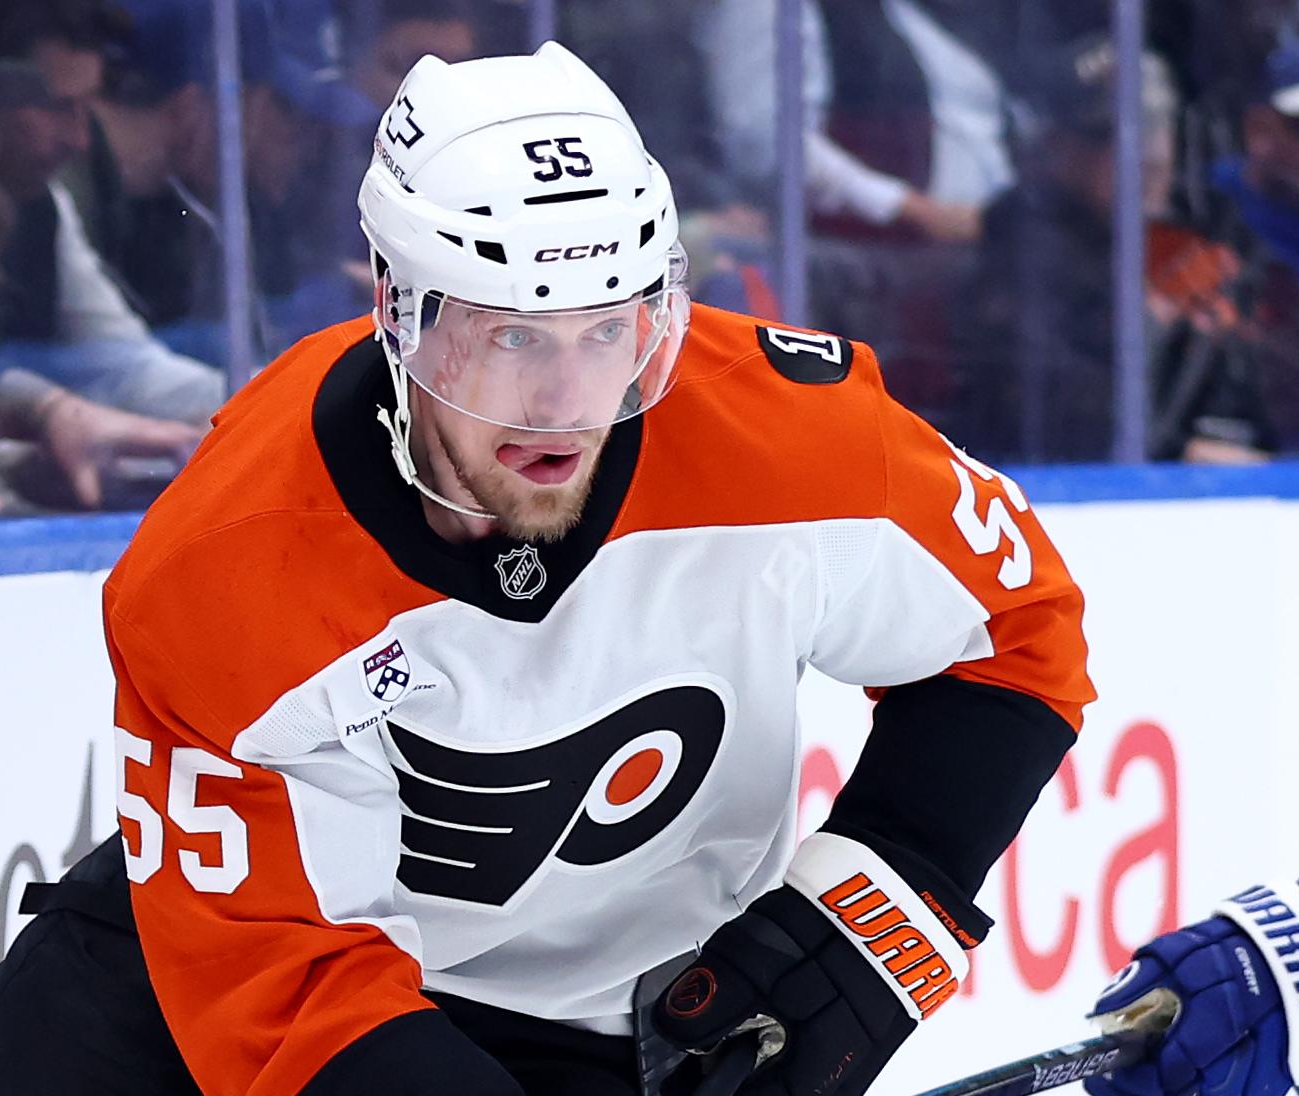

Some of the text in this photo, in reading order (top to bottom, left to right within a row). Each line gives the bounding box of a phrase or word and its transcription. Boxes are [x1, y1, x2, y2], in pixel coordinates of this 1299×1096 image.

[522, 137, 594, 183] 55
[534, 241, 620, 263] CCM
[511, 559, 533, 592] NHL
[345, 716, 378, 736] Penn
[114, 725, 249, 894] 55
